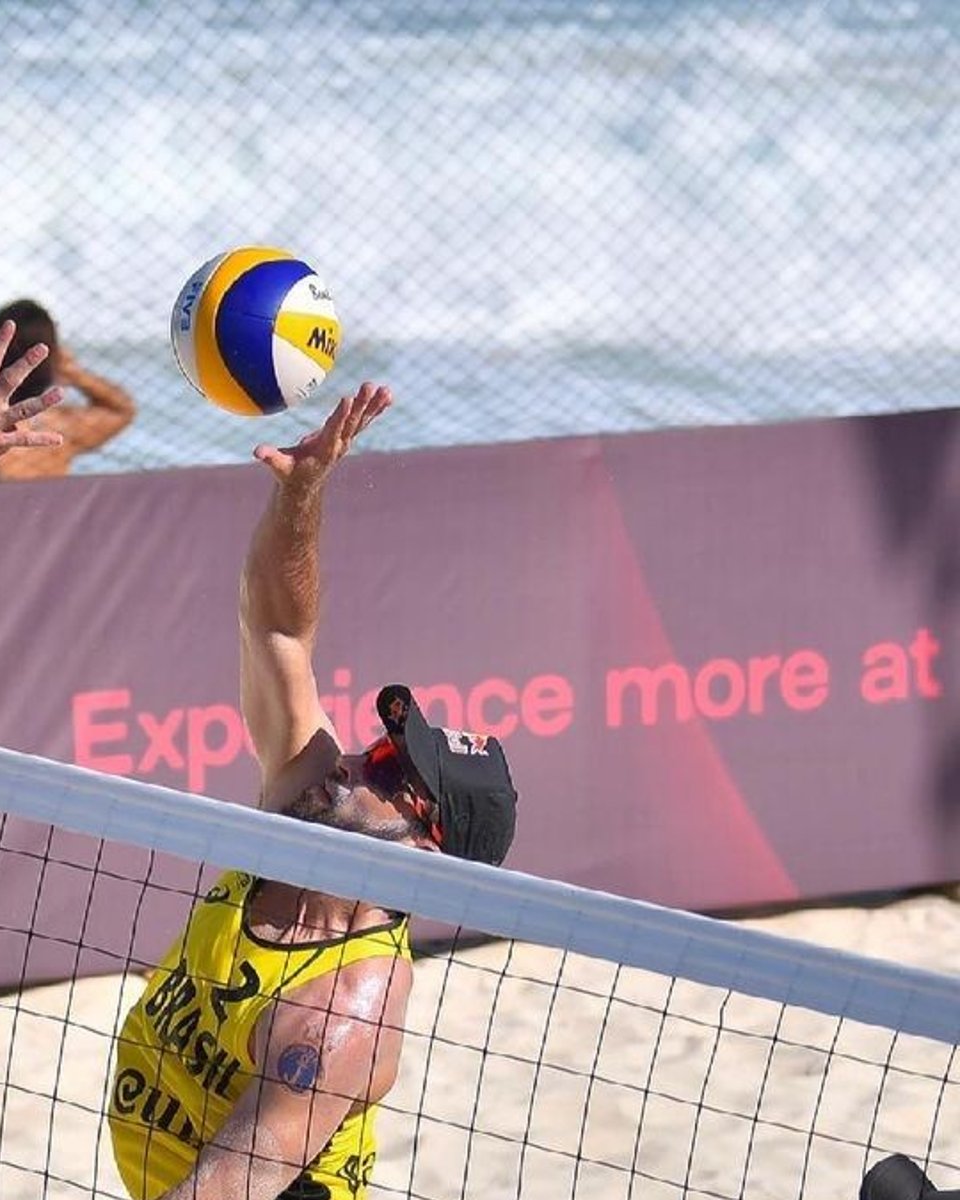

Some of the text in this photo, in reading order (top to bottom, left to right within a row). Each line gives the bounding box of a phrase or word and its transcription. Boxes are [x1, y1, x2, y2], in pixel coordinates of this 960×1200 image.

[71, 626, 945, 794] Expience more at
[209, 960, 261, 1024] 2
